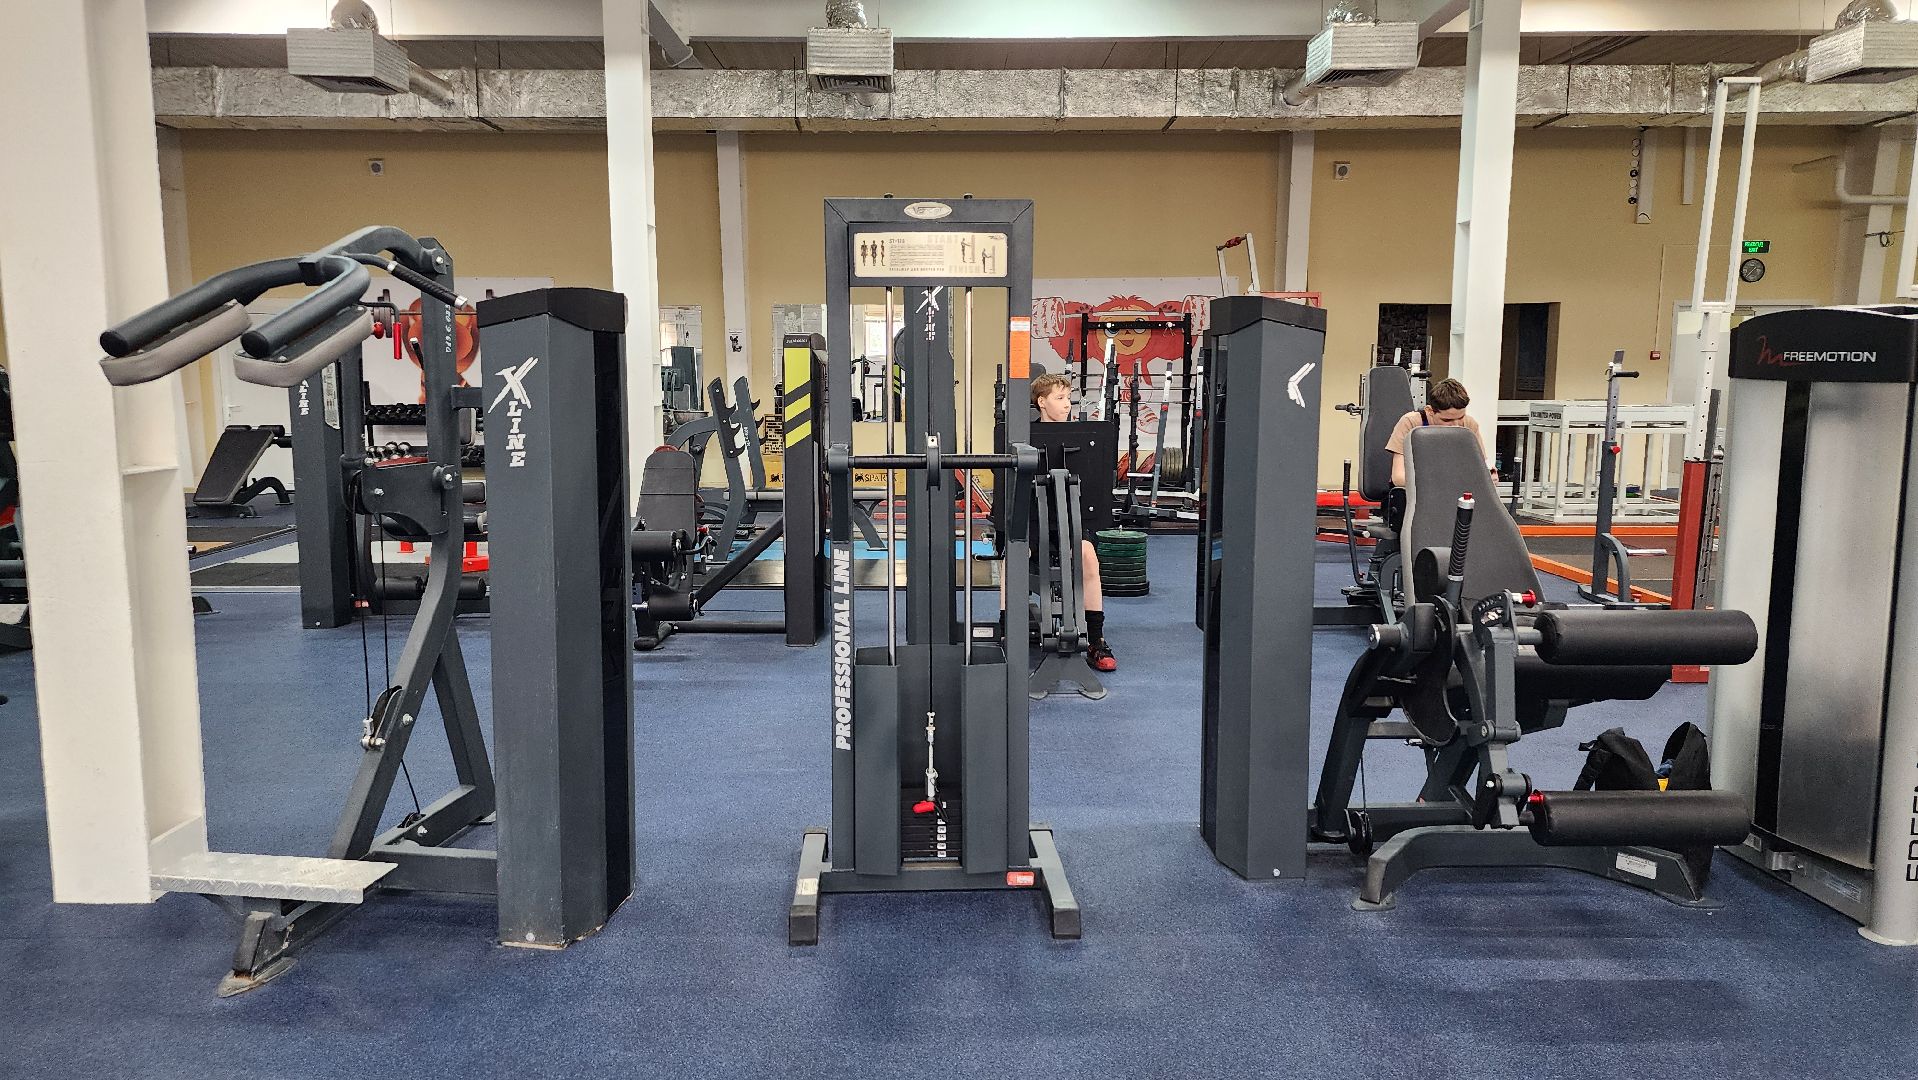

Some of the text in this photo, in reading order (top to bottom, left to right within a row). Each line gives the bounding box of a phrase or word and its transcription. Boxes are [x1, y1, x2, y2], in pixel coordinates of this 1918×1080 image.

[1783, 351, 1877, 363] FREEMOTION
[833, 548, 852, 751] PROFESSIONAL LINE
